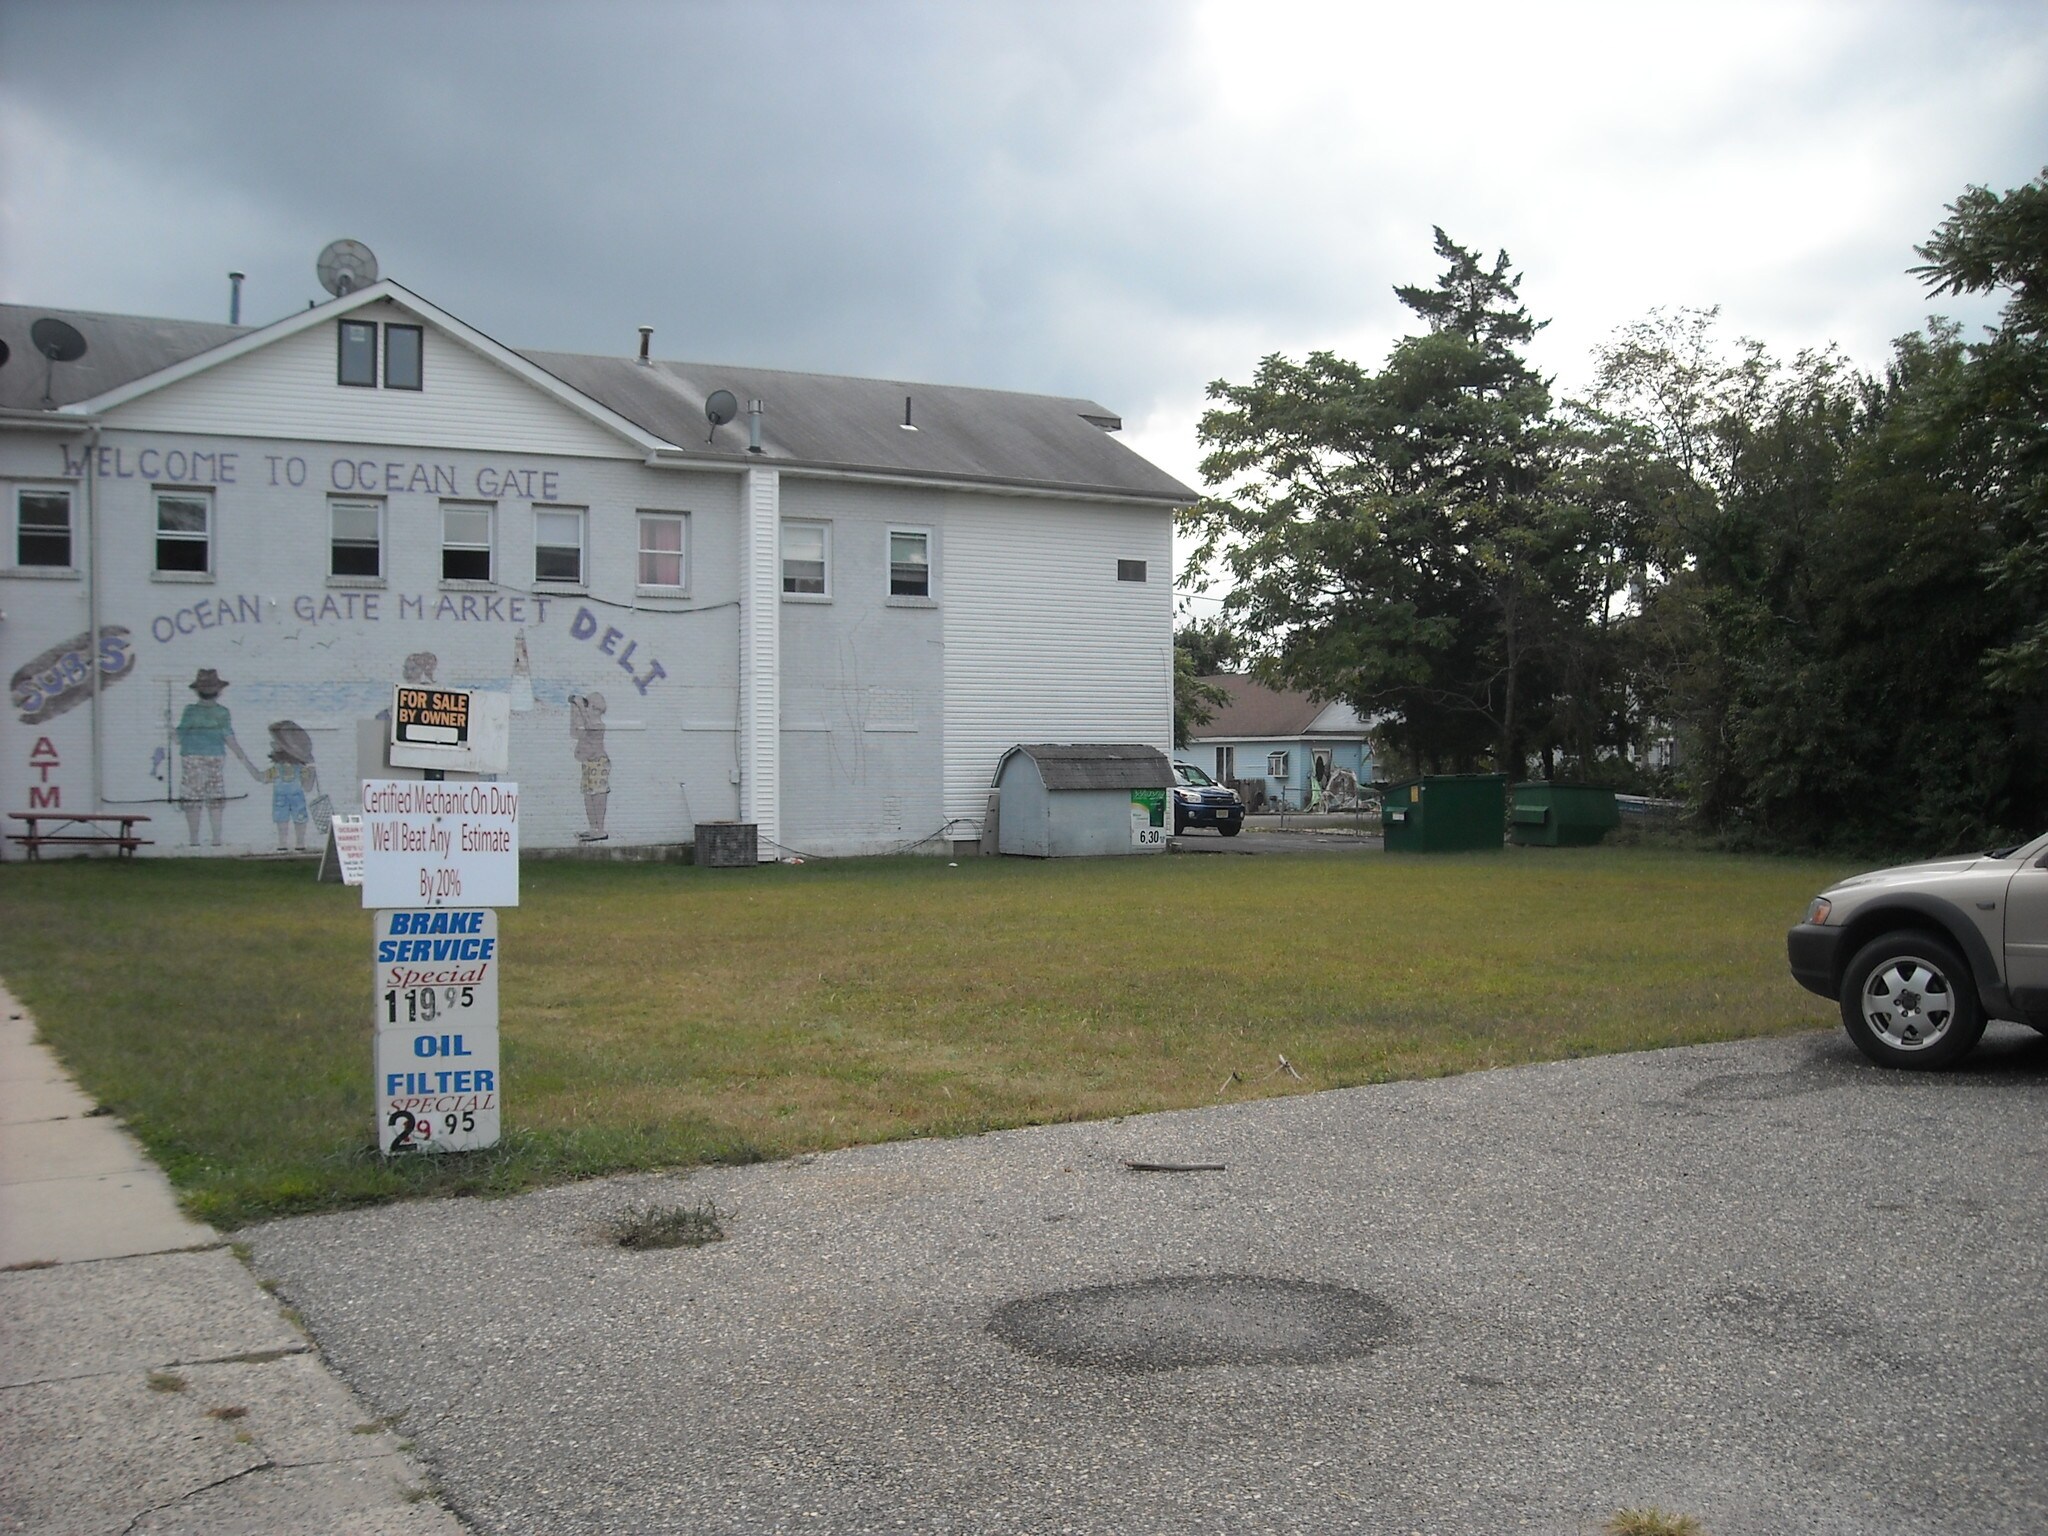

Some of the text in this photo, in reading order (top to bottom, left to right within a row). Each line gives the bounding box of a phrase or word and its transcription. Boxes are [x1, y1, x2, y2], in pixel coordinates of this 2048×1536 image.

[60, 444, 559, 500] WELCOME TO OCEAN GATE
[152, 594, 667, 696] OCEAN GATE MARKET DELI
[17, 635, 127, 712] SUBS
[400, 690, 467, 712] FOR SALE
[400, 708, 466, 727] BY OWNER
[29, 737, 60, 809] ATM
[363, 783, 518, 823] Certified Mechanic On Duty
[372, 822, 510, 860] We'll Beat Any Estimate
[1140, 830, 1159, 844] 6.30
[420, 868, 461, 904] By 20%
[389, 912, 484, 935] BRAKE
[379, 938, 495, 962] SERVICE
[387, 963, 487, 989] Special
[414, 1034, 472, 1057] OIL
[387, 1070, 494, 1096] FILTER
[387, 1094, 496, 1115] SPECIAL
